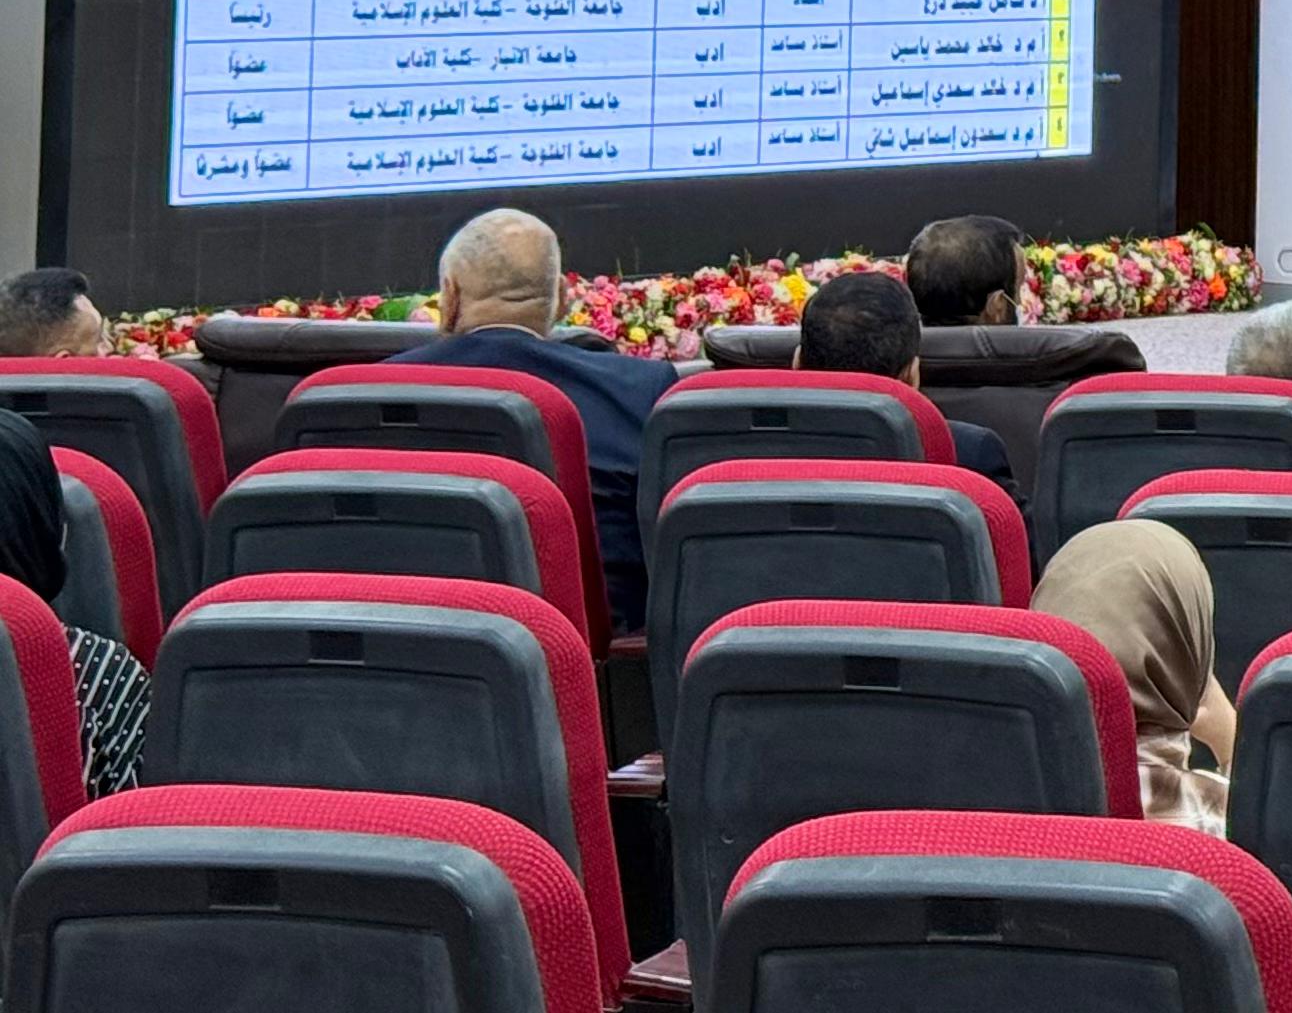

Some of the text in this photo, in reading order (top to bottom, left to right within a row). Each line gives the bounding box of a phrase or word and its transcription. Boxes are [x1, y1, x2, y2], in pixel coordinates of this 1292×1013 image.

[421, 0, 469, 25] العلوم
[537, 44, 577, 66] جامعة
[891, 36, 929, 62] ياسين
[523, 92, 573, 118] الفلوجة
[580, 91, 620, 113] جامعة
[932, 83, 974, 109] سعدي
[417, 98, 465, 122] العلوم
[960, 126, 1007, 149] سعدون
[416, 148, 464, 174] العلوم
[521, 143, 571, 166] الفلوجة
[579, 140, 618, 161] جامعة
